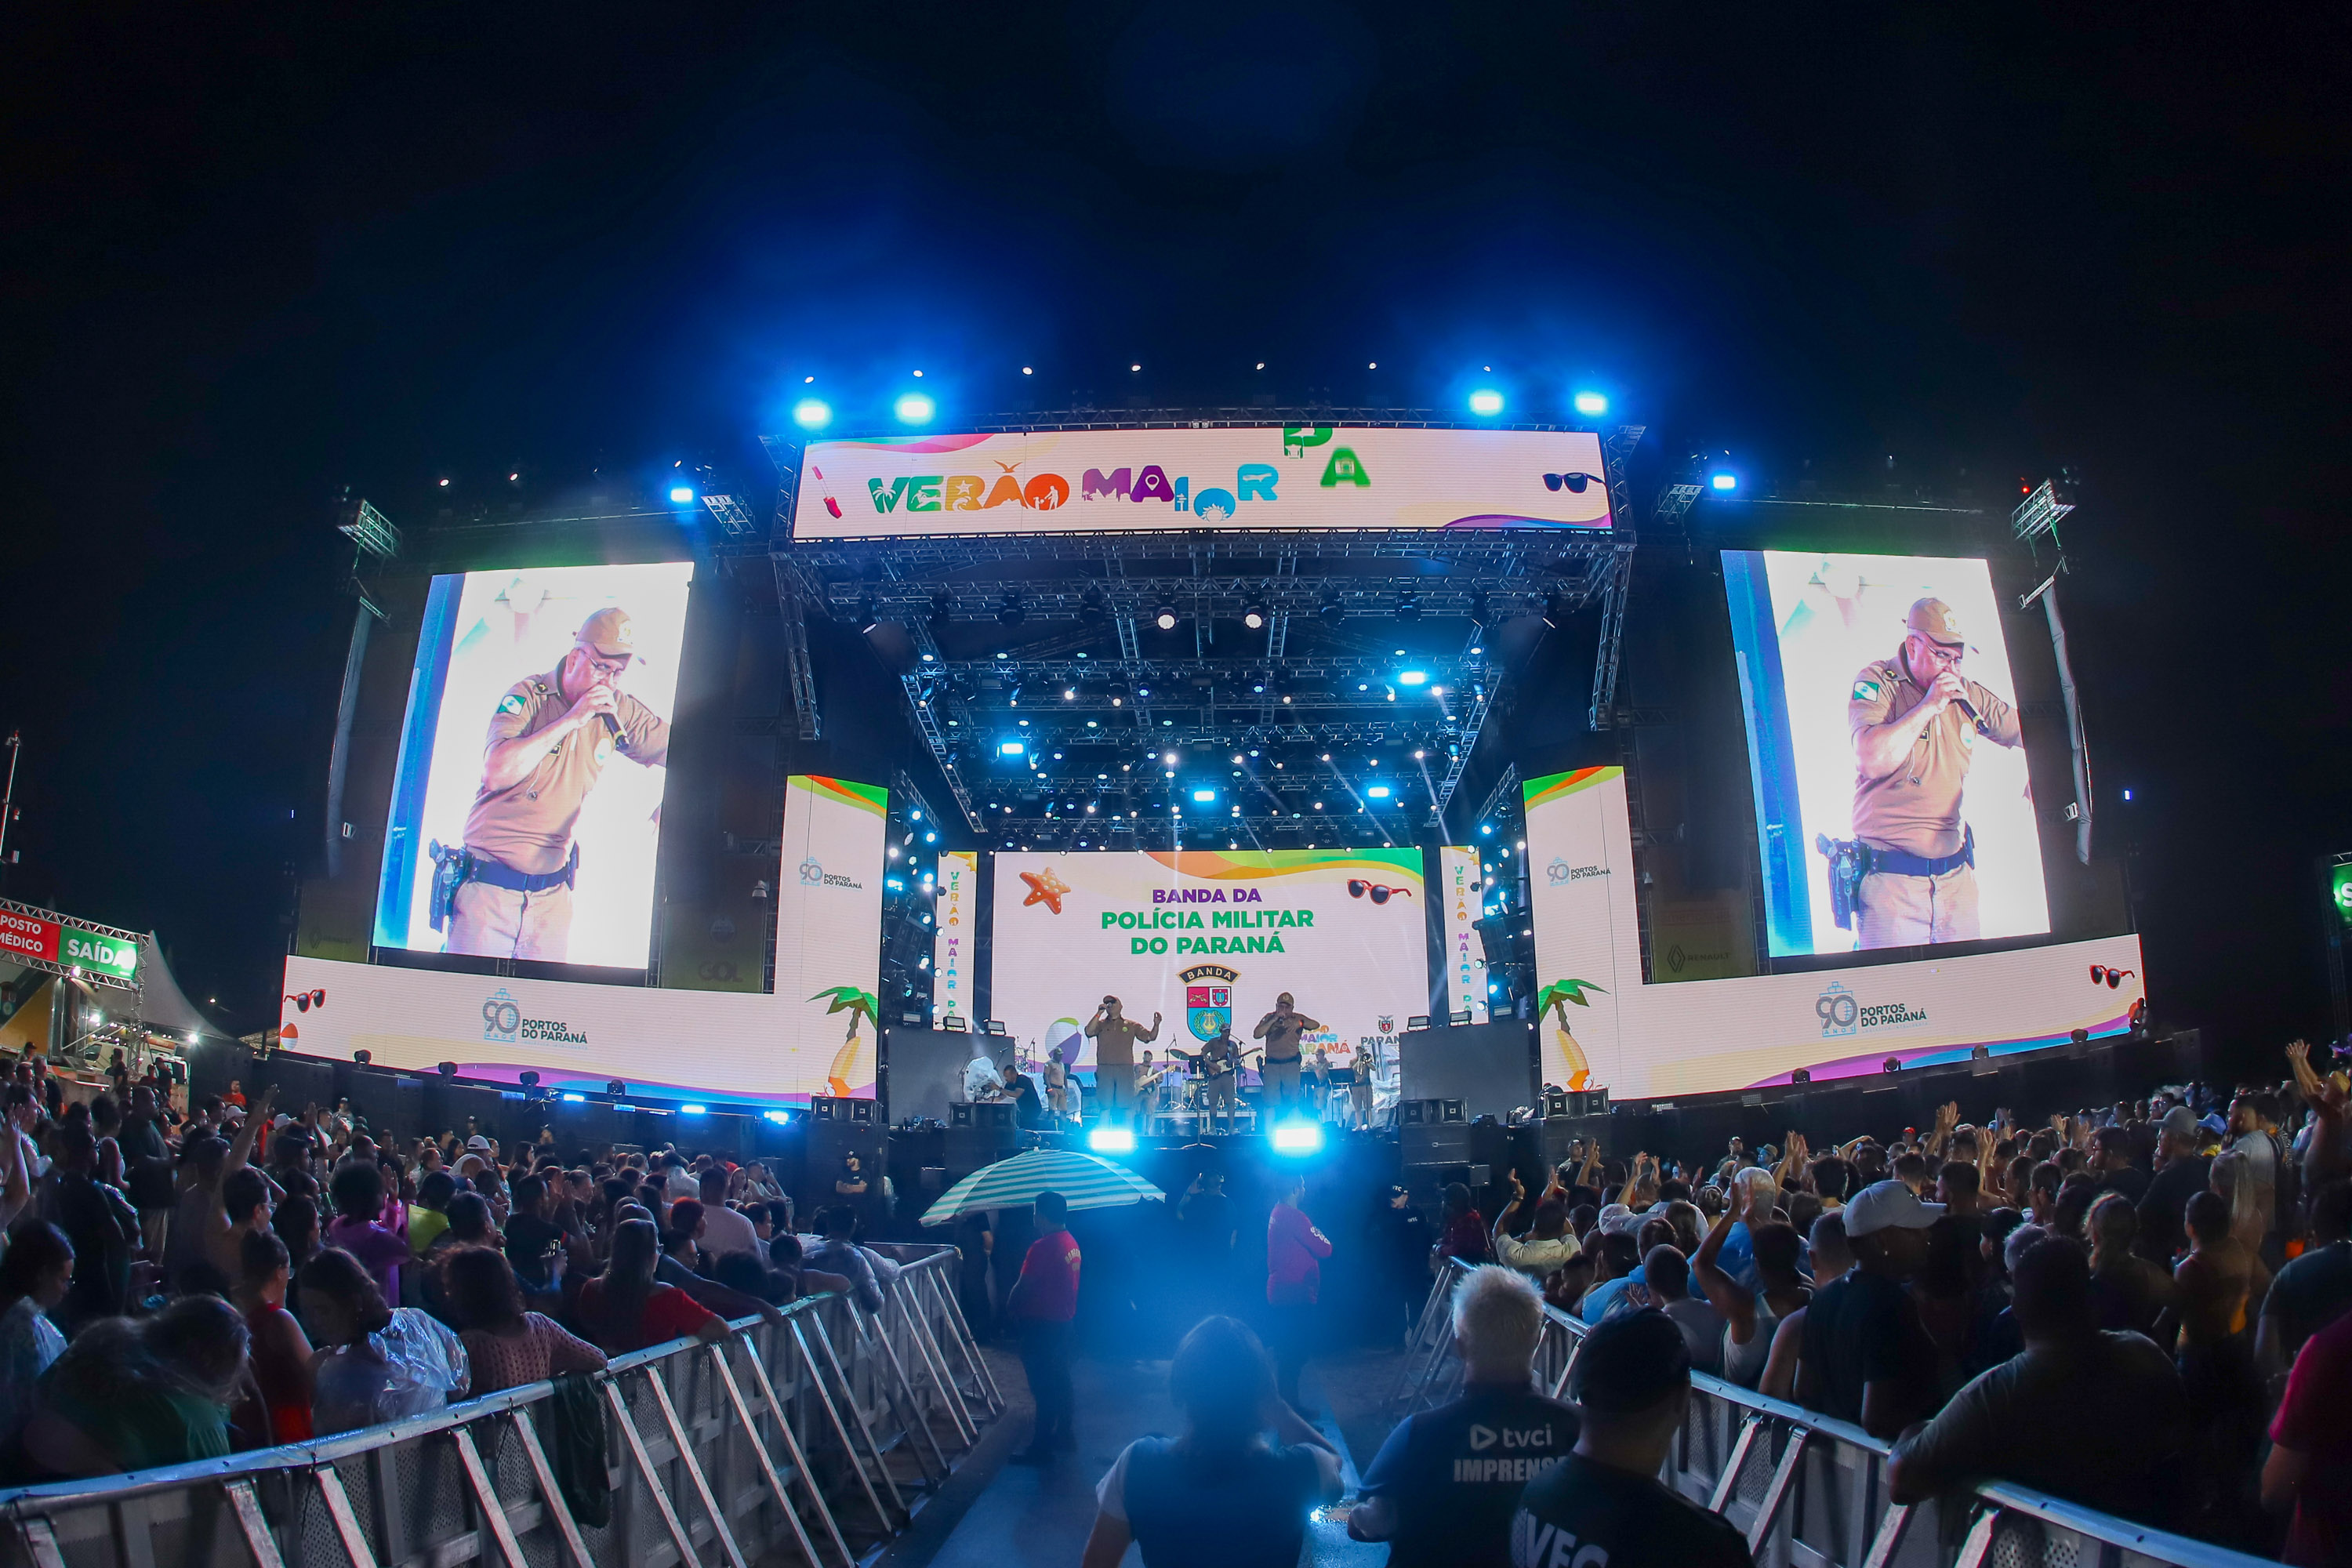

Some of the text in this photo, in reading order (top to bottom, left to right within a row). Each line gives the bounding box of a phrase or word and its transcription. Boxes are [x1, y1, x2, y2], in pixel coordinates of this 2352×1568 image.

[868, 460, 1069, 514] VERÃO
[1082, 463, 1279, 521] MAIOR
[824, 873, 851, 883] PORTOS
[1571, 866, 1598, 874] PORTOS
[1583, 868, 1611, 878] PARANÁ
[836, 881, 862, 890] PARANÁ
[1152, 888, 1262, 903] BANDA DA
[1455, 866, 1467, 920] VERÃO
[949, 872, 960, 926] VERÃO
[0, 914, 42, 935] POSTO
[1102, 907, 1314, 930] POLÍCIA MILITAR
[1131, 931, 1285, 955] DO PARANÁ
[67, 939, 131, 968] SAÍD
[947, 938, 959, 989] MAIOR
[1458, 933, 1471, 984] MAIOR
[1186, 967, 1232, 980] BANDA
[482, 1000, 521, 1033] 90
[1816, 995, 1857, 1029] 90
[1860, 1004, 1905, 1018] PORTOS
[1861, 1016, 1878, 1027] DO
[1881, 1008, 1927, 1025] PARANÁ
[521, 1018, 567, 1033] PORTOS
[1824, 1026, 1855, 1035] ANOS
[521, 1029, 588, 1044] DO PARANÁ
[1361, 1036, 1399, 1044] PARAN
[1298, 1040, 1351, 1054] ARANÁ
[1502, 1422, 1552, 1448] tvci
[1454, 1456, 1568, 1482] IMPREN
